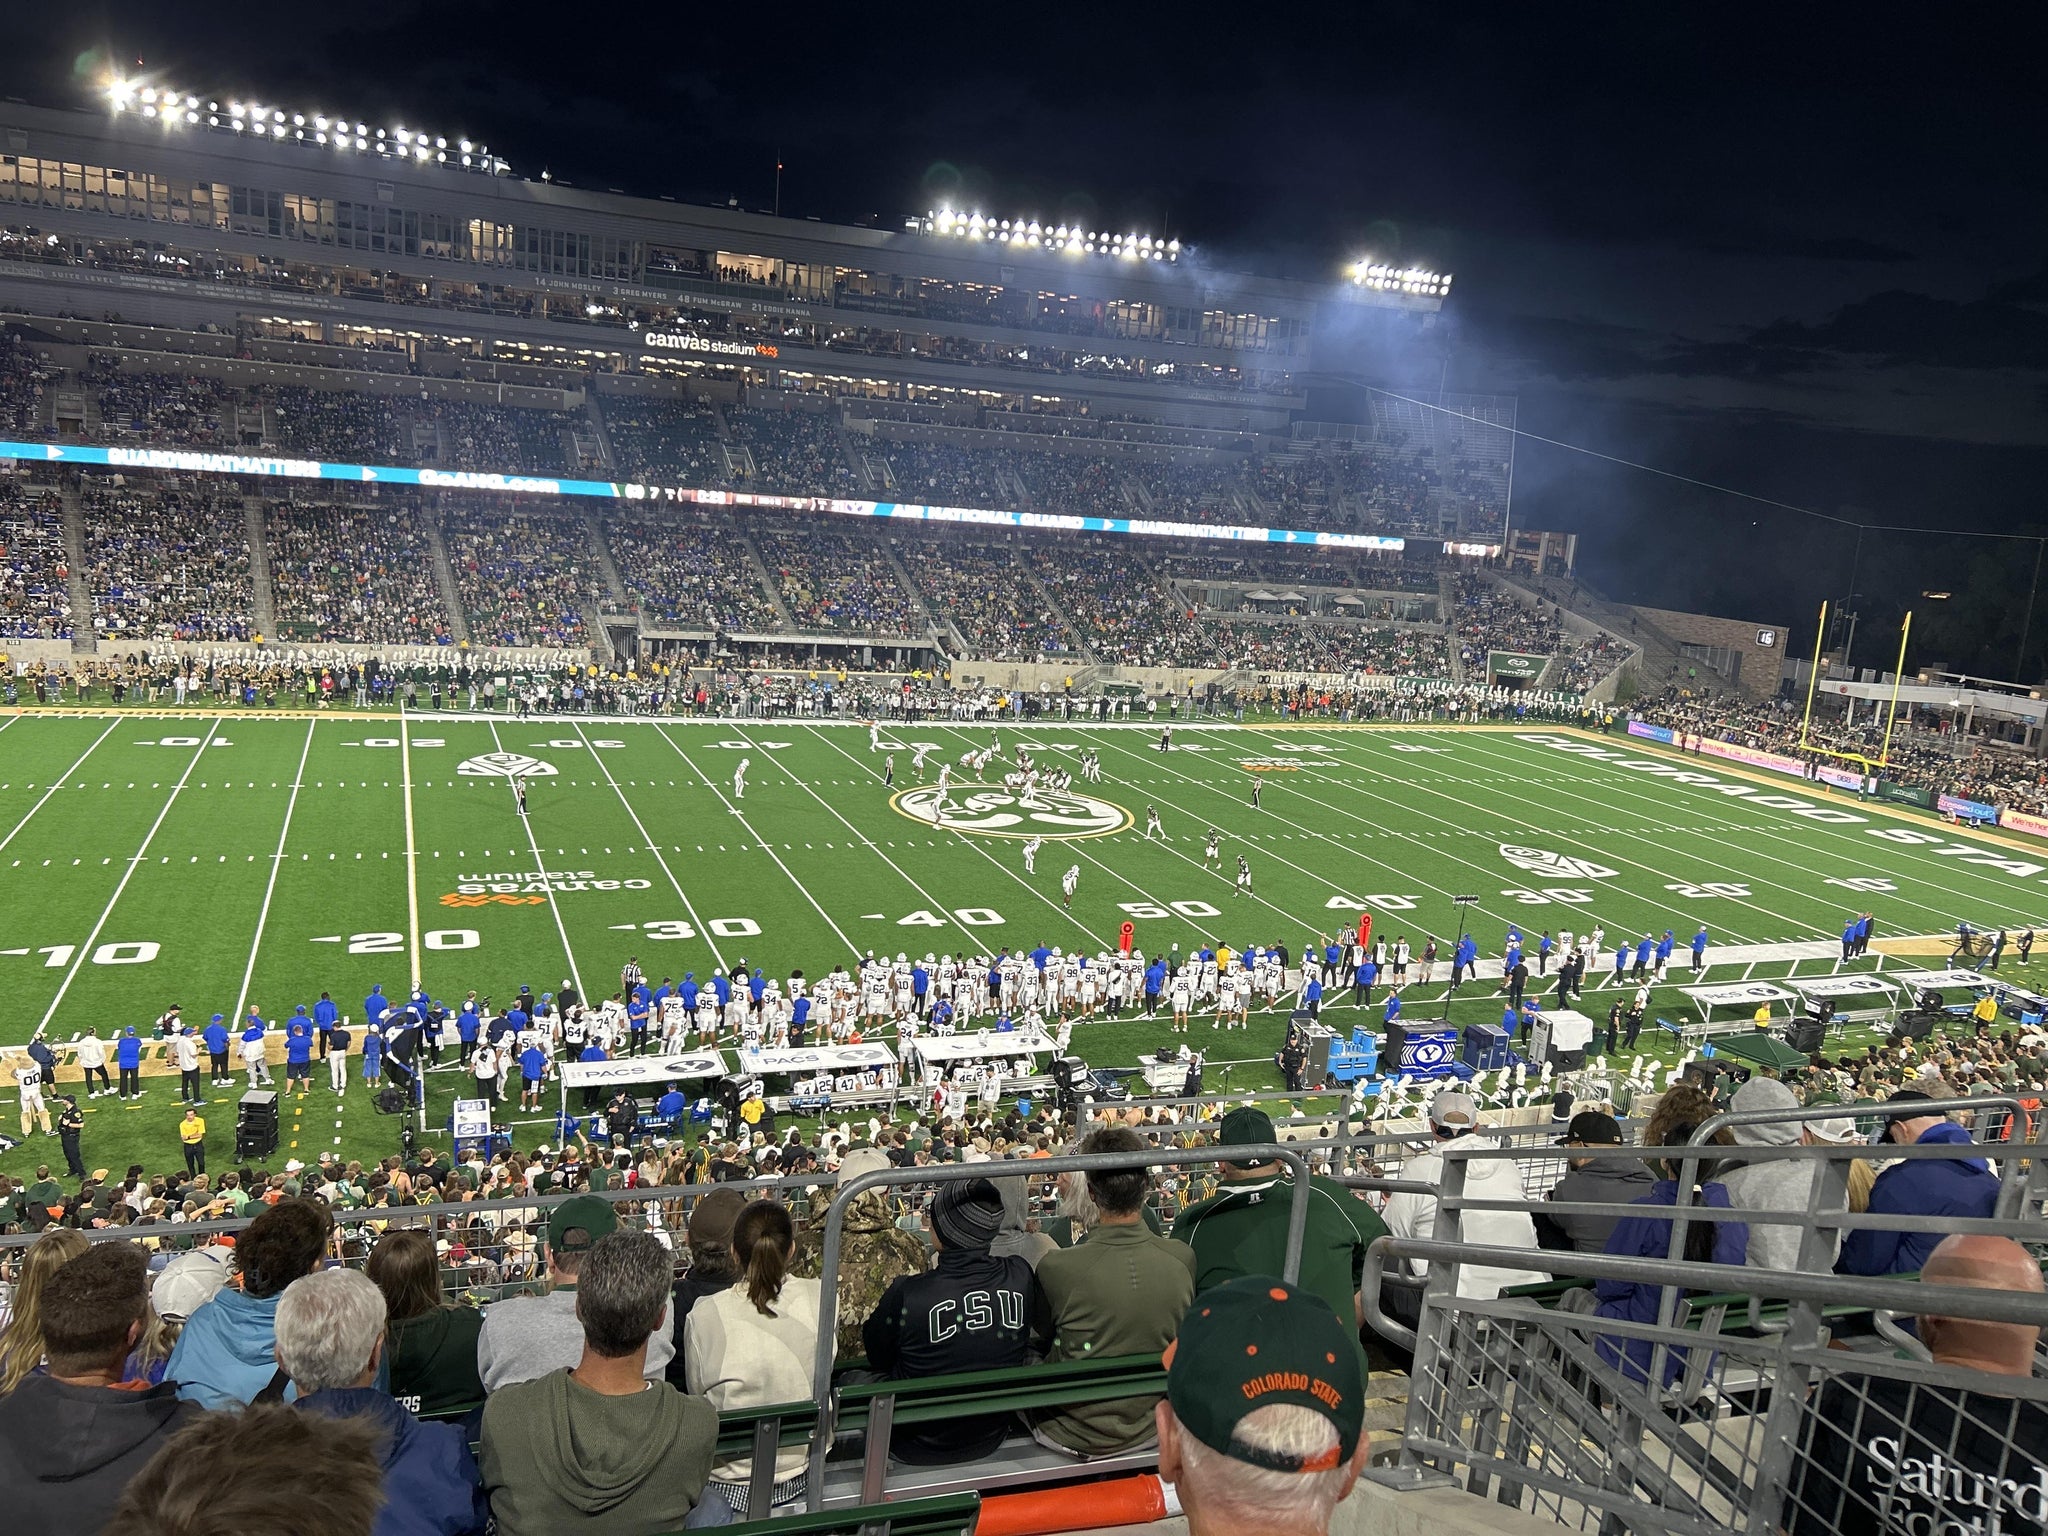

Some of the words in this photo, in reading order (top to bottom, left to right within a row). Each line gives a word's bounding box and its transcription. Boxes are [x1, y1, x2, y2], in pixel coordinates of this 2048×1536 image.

[535, 277, 546, 287] 14
[549, 281, 570, 289] JOHN
[571, 282, 601, 292] MOSLEY
[612, 286, 620, 295] 3
[620, 289, 640, 297] GREG
[641, 290, 667, 300] MYERS
[678, 294, 690, 303] 48
[692, 297, 709, 305] FUM
[752, 303, 762, 312] 21
[645, 331, 710, 352] canvas
[711, 342, 757, 357] stadium
[927, 506, 1018, 526] NATIONAL
[1019, 513, 1085, 530] GUARD
[160, 737, 235, 747] 10
[363, 738, 446, 748] 20
[550, 739, 626, 748] 30
[718, 740, 792, 749] 40
[1513, 734, 1871, 824] COLORADO
[1864, 828, 2048, 884] STA
[1974, 808, 1995, 818] out?
[2011, 816, 2034, 827] We're
[2034, 820, 2048, 831] her
[458, 871, 596, 882] stadium
[457, 879, 652, 895] canvas
[1663, 881, 1754, 899] 20
[1822, 877, 1898, 891] 10
[1500, 887, 1594, 904] 30
[1324, 894, 1418, 911] 40
[1116, 900, 1222, 919] 50
[897, 908, 1006, 927] 40
[643, 917, 763, 940] 30
[348, 929, 481, 954] 20
[37, 940, 161, 968] 10
[1066, 968, 1078, 978] 99
[1085, 973, 1096, 983] 93
[872, 984, 885, 994] 62
[1177, 982, 1189, 991] 59
[1223, 982, 1235, 992] 82
[700, 999, 713, 1010] 95
[538, 1023, 551, 1035] 51
[596, 1017, 610, 1029] 74
[567, 1026, 582, 1038] 64
[744, 1030, 757, 1040] 20
[900, 1027, 912, 1038] 24
[1421, 1046, 1439, 1061] Y
[763, 1054, 820, 1067] PACS
[23, 1072, 41, 1087] 00
[584, 1066, 646, 1080] PACS
[819, 1080, 832, 1092] 25
[841, 1078, 854, 1091] 47
[864, 1074, 875, 1086] 10
[929, 1289, 1025, 1343] CSU
[1242, 1371, 1309, 1400] COLORADO
[1310, 1378, 1343, 1410] STATE
